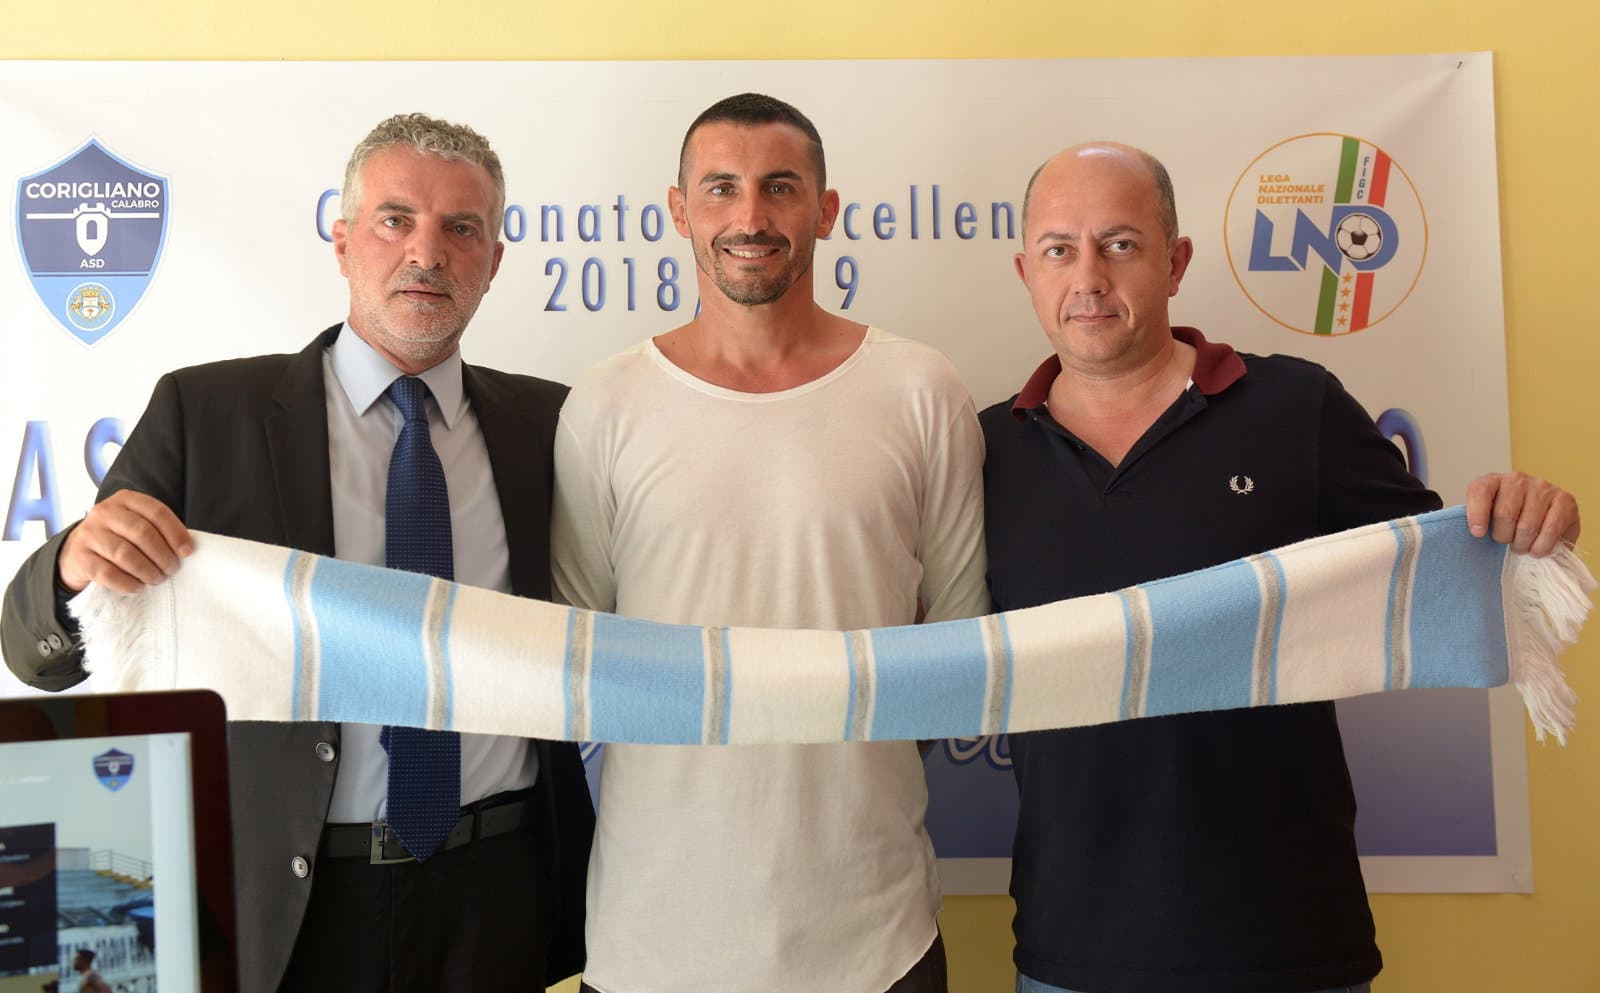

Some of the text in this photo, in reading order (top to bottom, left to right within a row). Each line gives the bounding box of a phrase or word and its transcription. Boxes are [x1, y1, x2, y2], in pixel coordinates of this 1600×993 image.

[1260, 174, 1291, 183] LEGA
[1356, 156, 1371, 200] FIGC
[26, 182, 160, 199] CORIGLIANO
[1258, 184, 1325, 193] NAZIONALE
[111, 200, 160, 208] CALABRO
[1257, 195, 1324, 205] DILETTANTI
[316, 189, 665, 242] Conato
[80, 258, 105, 269] ASD
